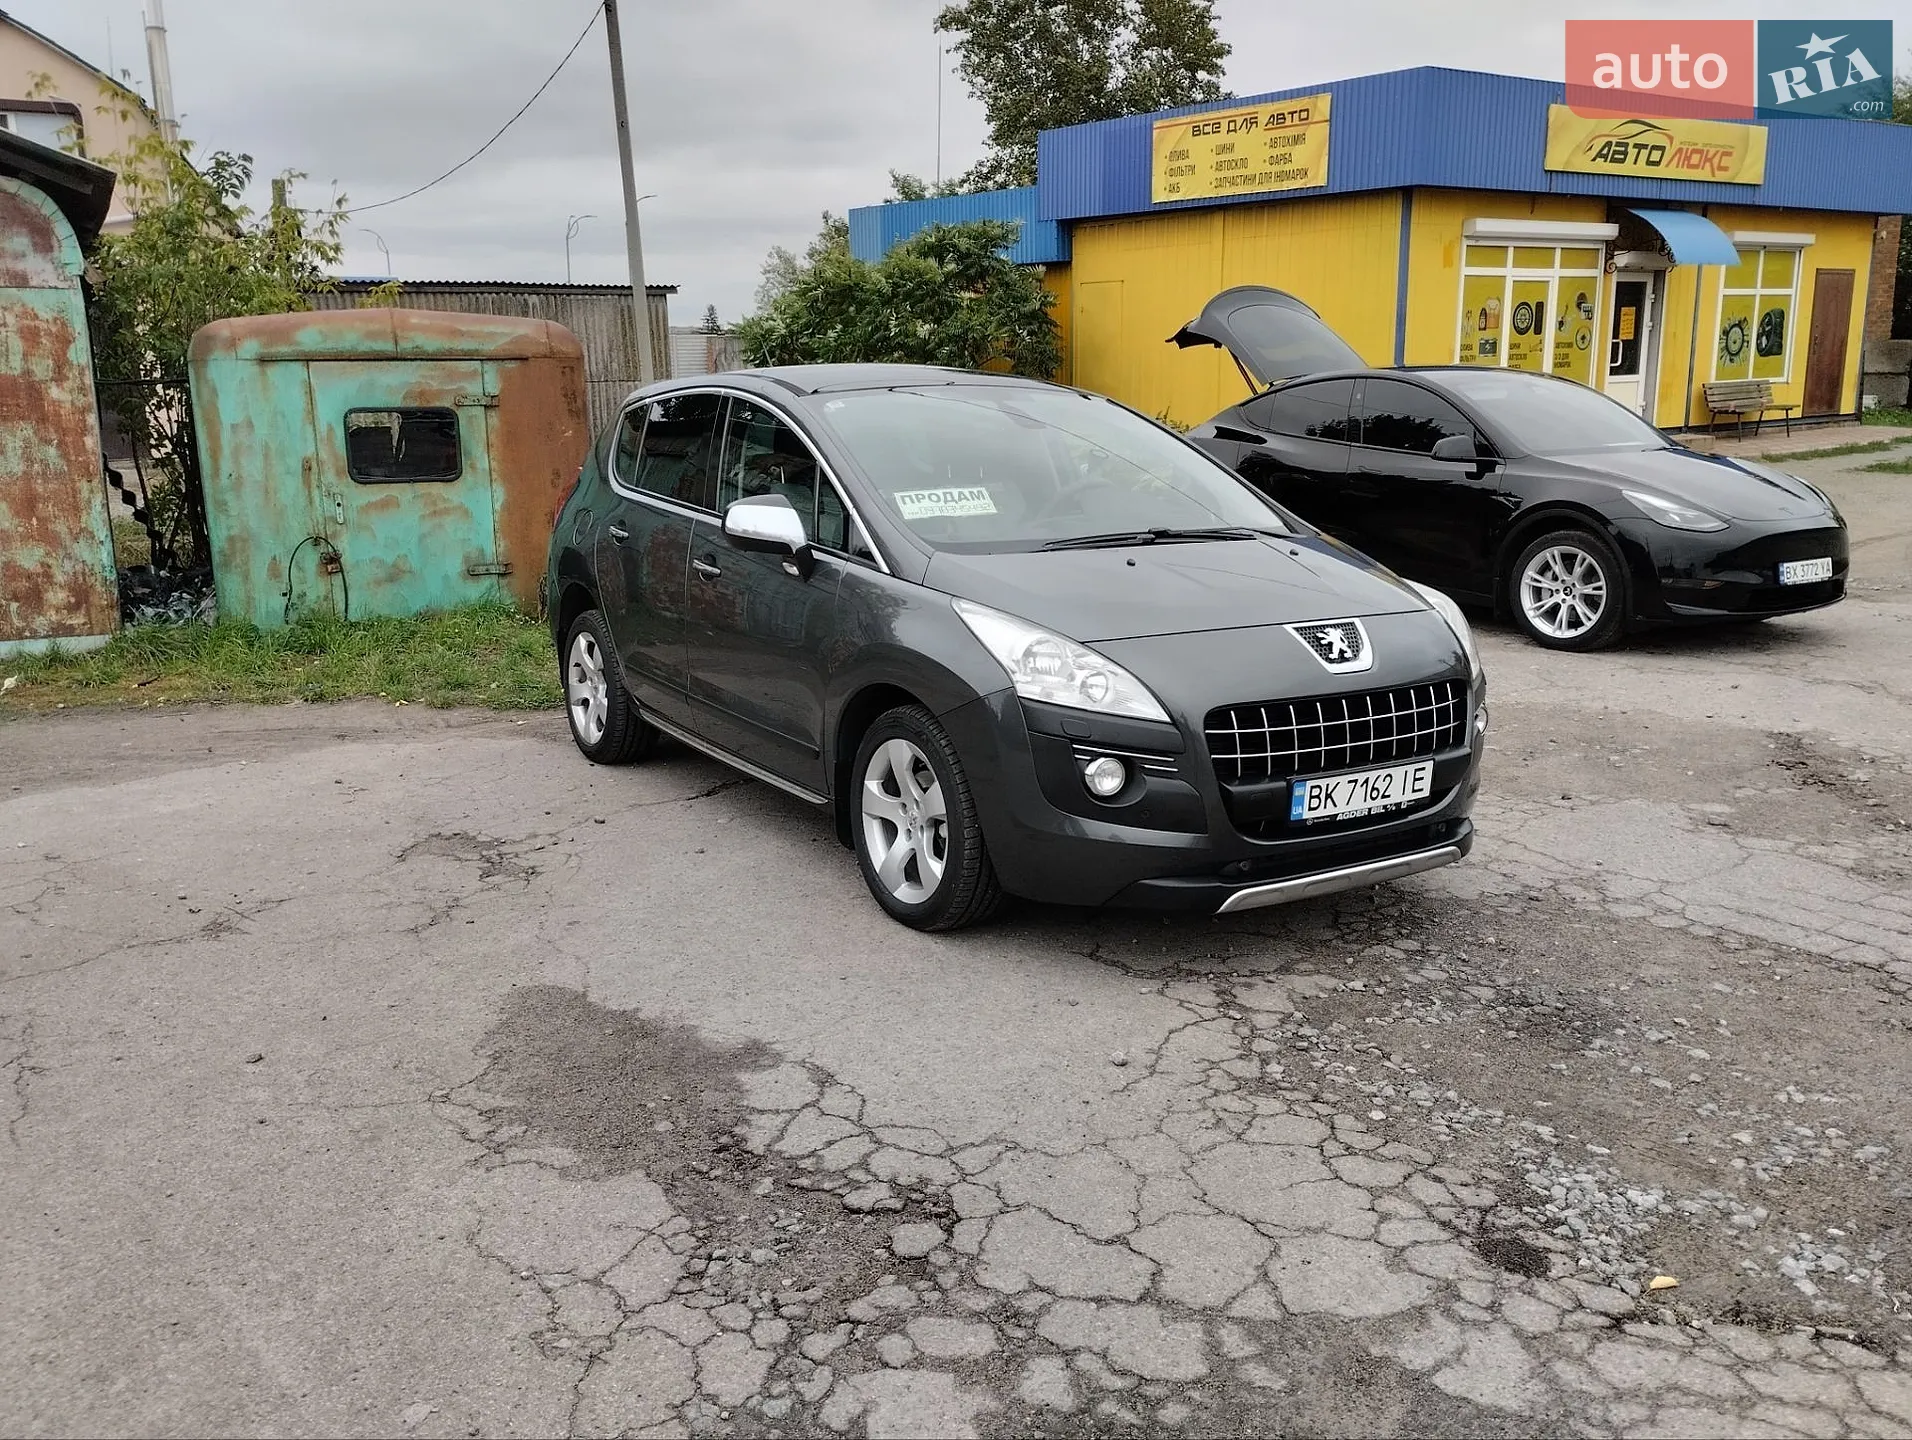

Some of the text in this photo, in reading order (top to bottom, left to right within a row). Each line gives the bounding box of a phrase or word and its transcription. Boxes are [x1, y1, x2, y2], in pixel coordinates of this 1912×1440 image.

[1191, 108, 1310, 137] ВСЕ ДЛЯ АВТО
[1215, 142, 1235, 156] ШИНИ
[1268, 133, 1306, 150] АВТОХІМІЯ
[1168, 149, 1190, 162] ОЛИВА
[1268, 152, 1293, 166] ФАРБА
[1168, 165, 1196, 178] ФІЛЬТРИ
[1215, 157, 1249, 172] АВТОСКЛО
[1214, 167, 1310, 189] ЗАПЧАСТИНИ ДЛЯ ІНОМАРОК
[1168, 181, 1181, 194] АКБ
[900, 489, 986, 505] ПРОДАМ
[1785, 566, 1799, 580] BX
[1800, 562, 1819, 578] 3772
[1307, 766, 1427, 812] BK 7162 IE
[1336, 808, 1369, 821] AGDER
